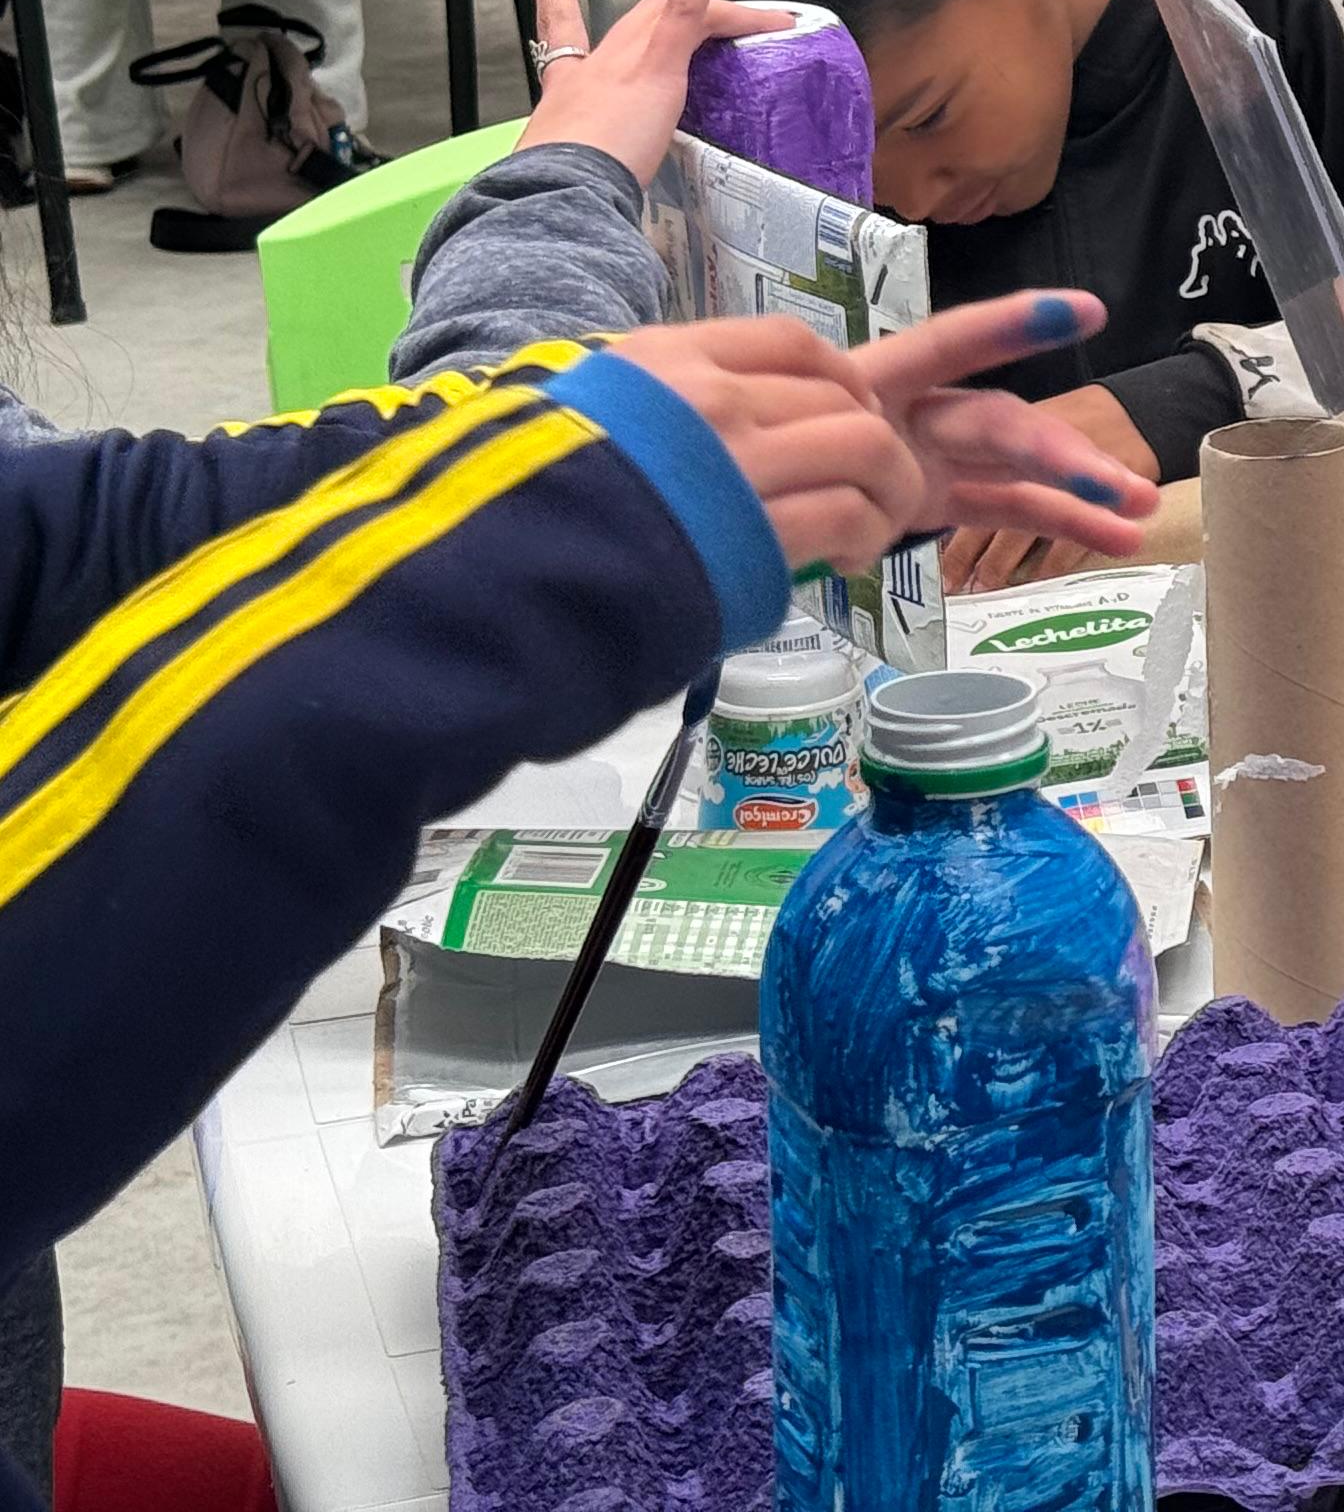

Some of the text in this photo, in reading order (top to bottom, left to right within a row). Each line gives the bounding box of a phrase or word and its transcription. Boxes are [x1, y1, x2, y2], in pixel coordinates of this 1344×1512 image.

[989, 616, 1149, 653] Lechelita
[1073, 718, 1107, 735] 1%
[726, 750, 777, 775] LECHE
[784, 742, 846, 772] DULCE
